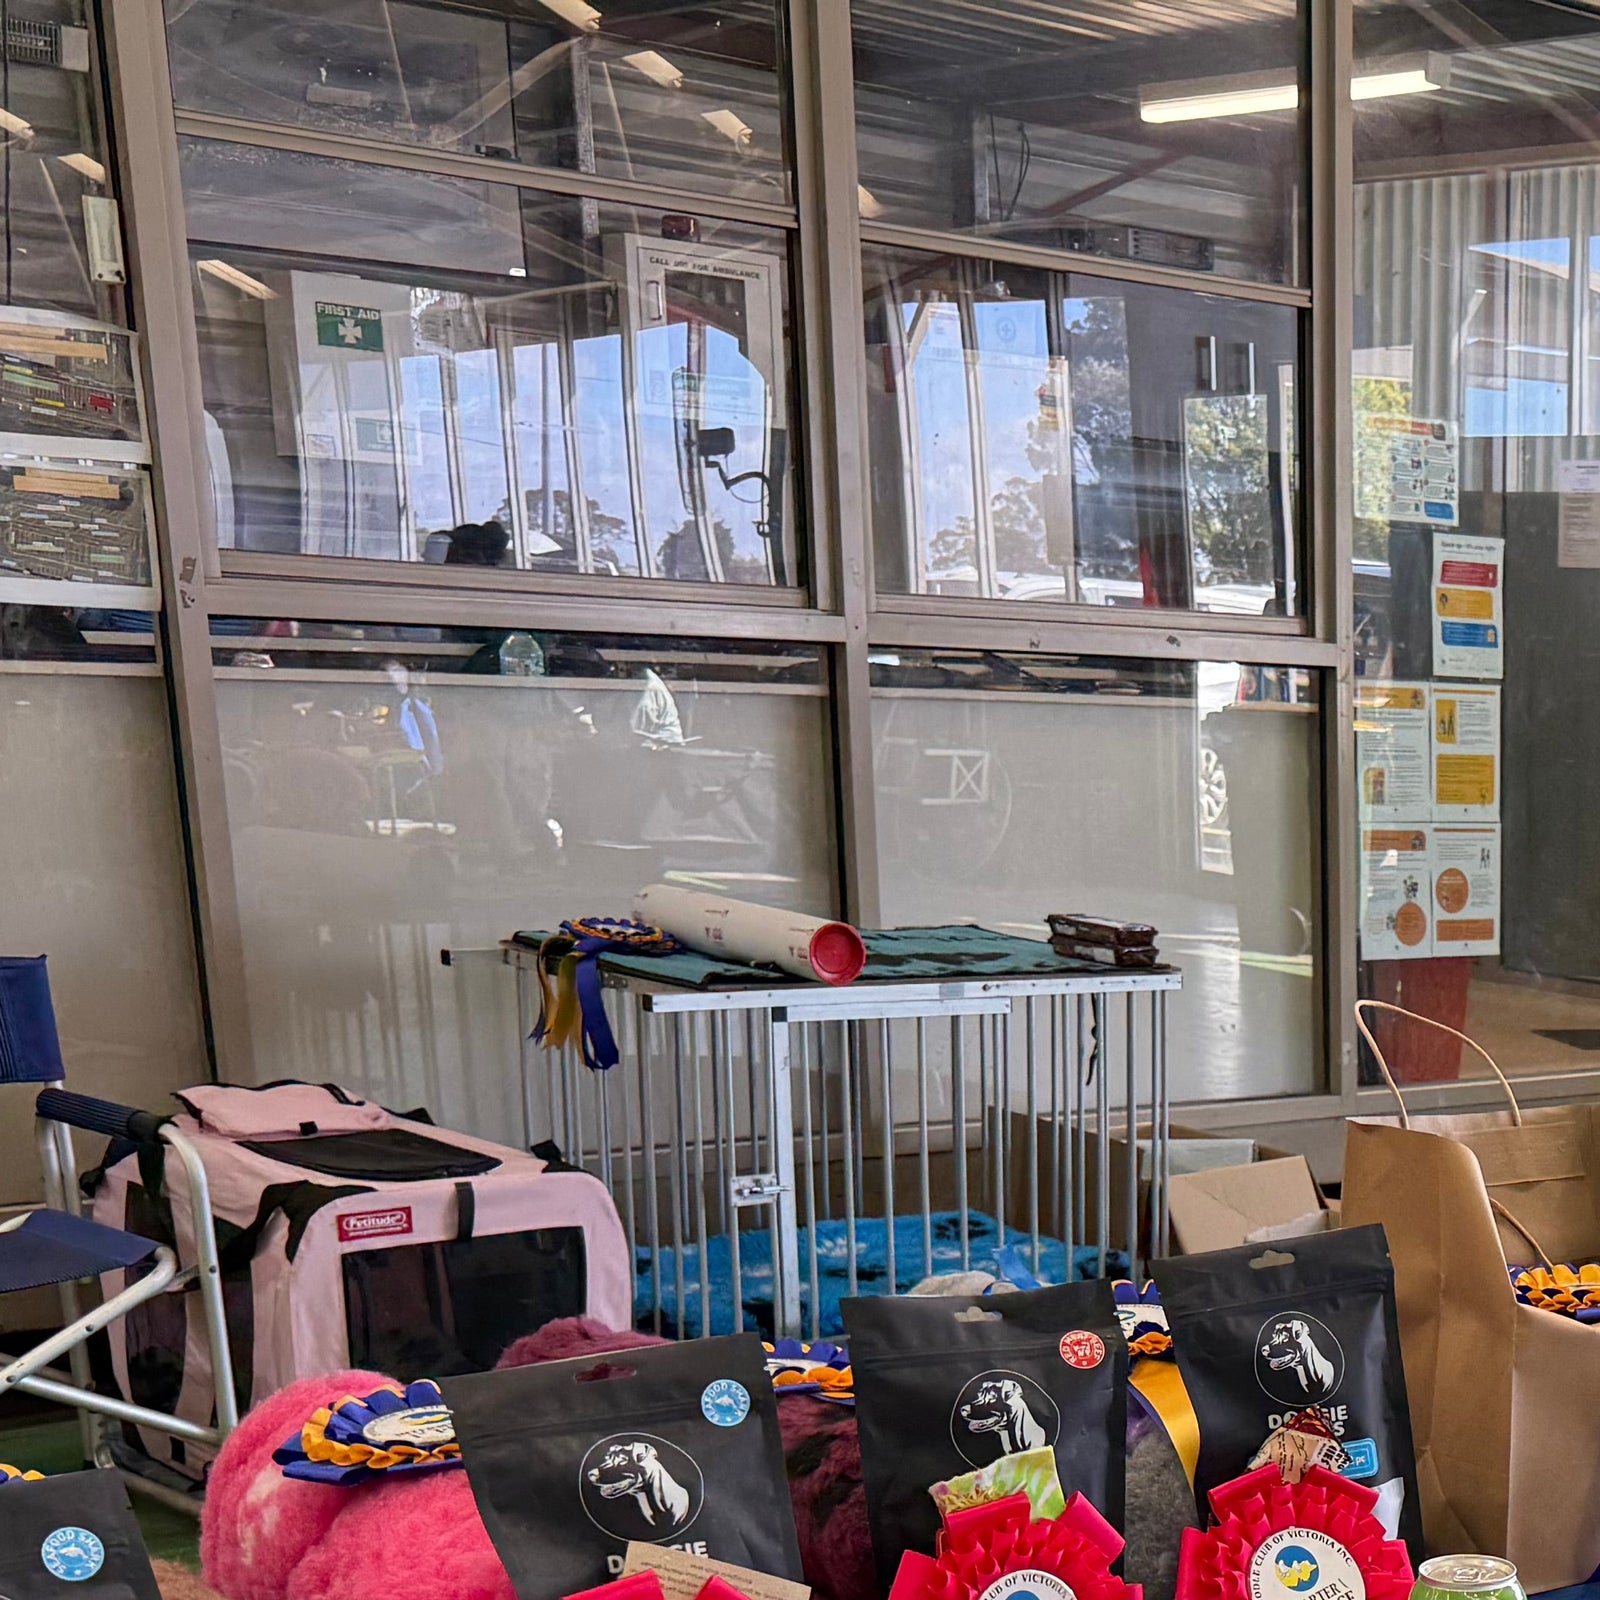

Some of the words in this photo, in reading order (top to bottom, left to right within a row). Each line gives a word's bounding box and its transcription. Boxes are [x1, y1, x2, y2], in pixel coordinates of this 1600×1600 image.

[650, 256, 669, 266] CALL
[692, 262, 709, 272] FOR
[713, 265, 760, 280] AMBULANCE
[317, 302, 351, 317] FIRST
[357, 308, 380, 321] AID
[1065, 1333, 1088, 1345] MEAT
[1090, 1338, 1102, 1361] BEEF
[1062, 1346, 1077, 1364] RED
[703, 1382, 730, 1423] SEAFOOD
[45, 1530, 75, 1574] SEAFOOD
[78, 1533, 103, 1575] SHARK
[1255, 1544, 1273, 1567] CLUB
[1272, 1533, 1285, 1544] OF
[1287, 1530, 1335, 1549] VICTORIA
[1005, 1575, 1019, 1588] OF
[1021, 1573, 1067, 1598] VICTORIA
